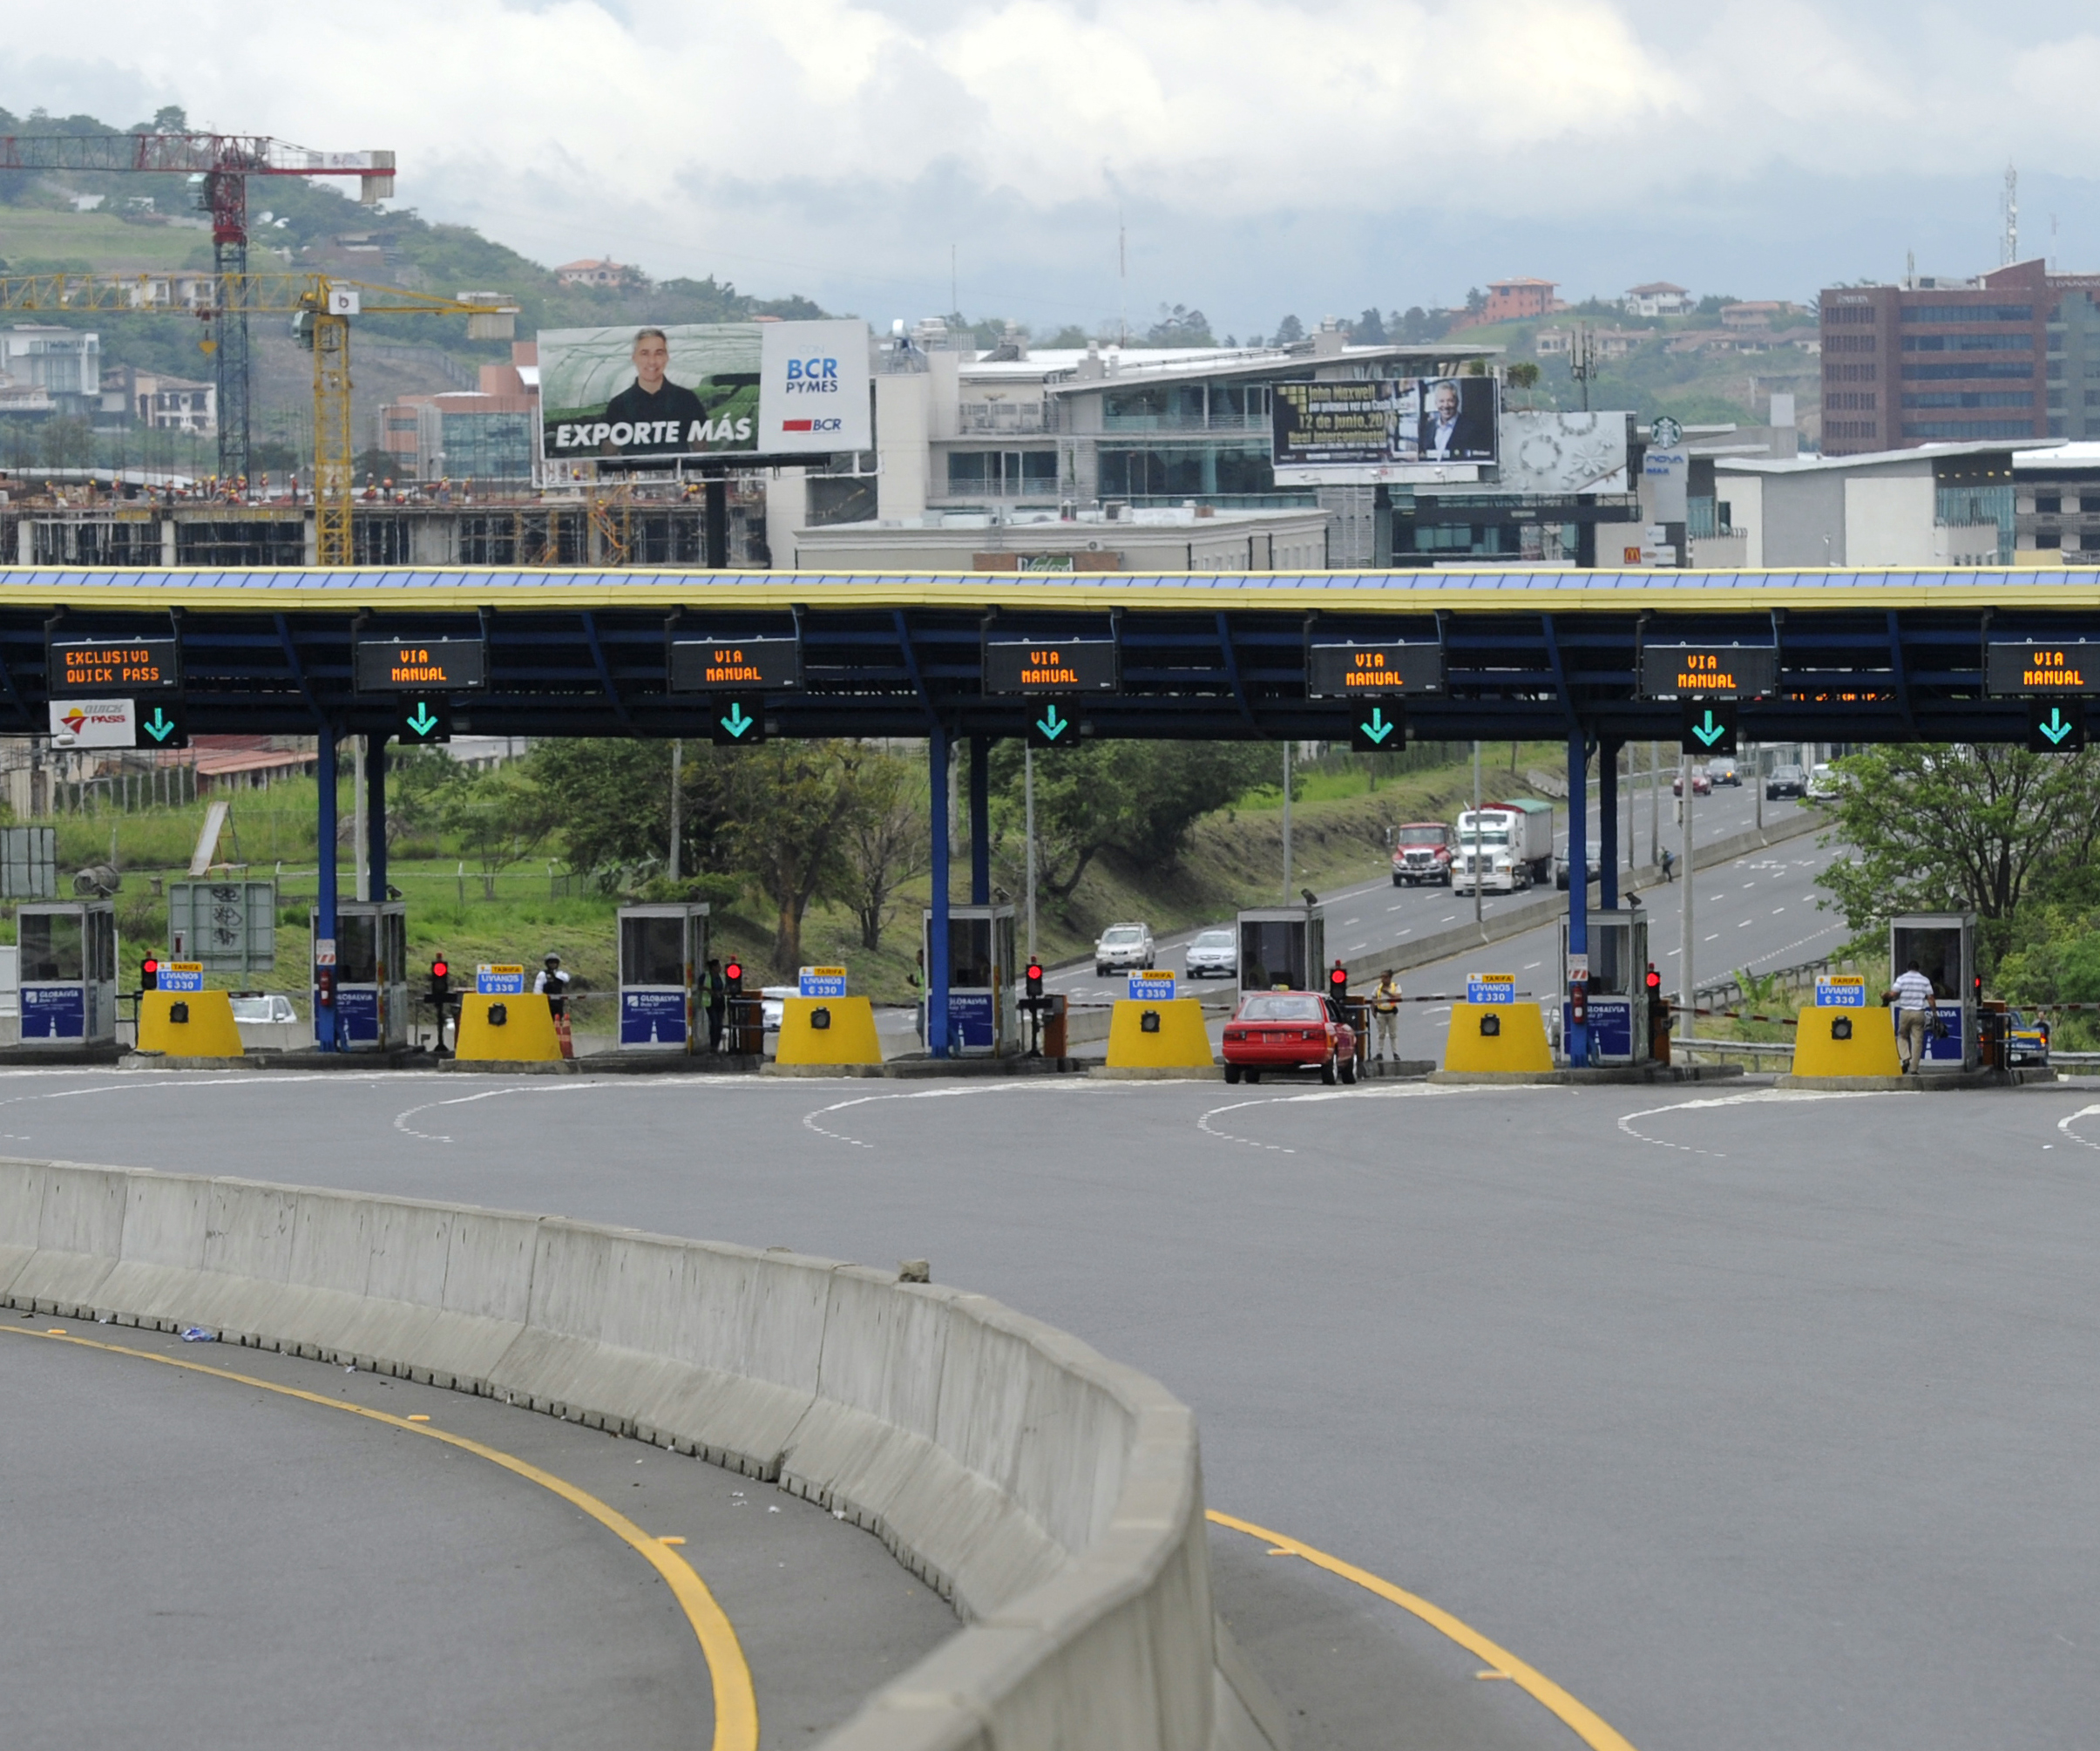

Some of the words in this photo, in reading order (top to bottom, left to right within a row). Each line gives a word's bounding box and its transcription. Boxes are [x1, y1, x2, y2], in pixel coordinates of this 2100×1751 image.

[787, 357, 837, 380] BCR
[786, 380, 838, 394] PYMES
[812, 418, 842, 431] BCR
[1299, 414, 1313, 429] 12
[1316, 414, 1331, 428] de
[556, 421, 681, 447] EXPORTE
[687, 412, 751, 443] MÁS
[65, 650, 149, 666] EXCLUSIVO
[401, 649, 428, 663] VIA
[715, 649, 742, 663] VIA
[1030, 651, 1060, 665] VIA
[1355, 653, 1385, 668] VIA
[1687, 655, 1717, 669] VIA
[2034, 651, 2063, 666] VIA
[66, 669, 113, 683] QUICK
[122, 667, 159, 682] PASS
[391, 667, 447, 682] MANUAL
[706, 667, 762, 682] MANUAL
[1021, 669, 1078, 683] MANUAL
[1345, 671, 1404, 686] MANUAL
[1677, 673, 1737, 689] MANUAL
[2023, 669, 2084, 685] MANUAL
[84, 704, 125, 715] QUICK
[91, 715, 126, 724] PASS
[174, 981, 193, 989] 330
[496, 983, 514, 992] 330
[817, 986, 837, 994] 330
[1147, 988, 1166, 998] 330
[1486, 993, 1506, 1001] 330
[1835, 995, 1854, 1004] 330
